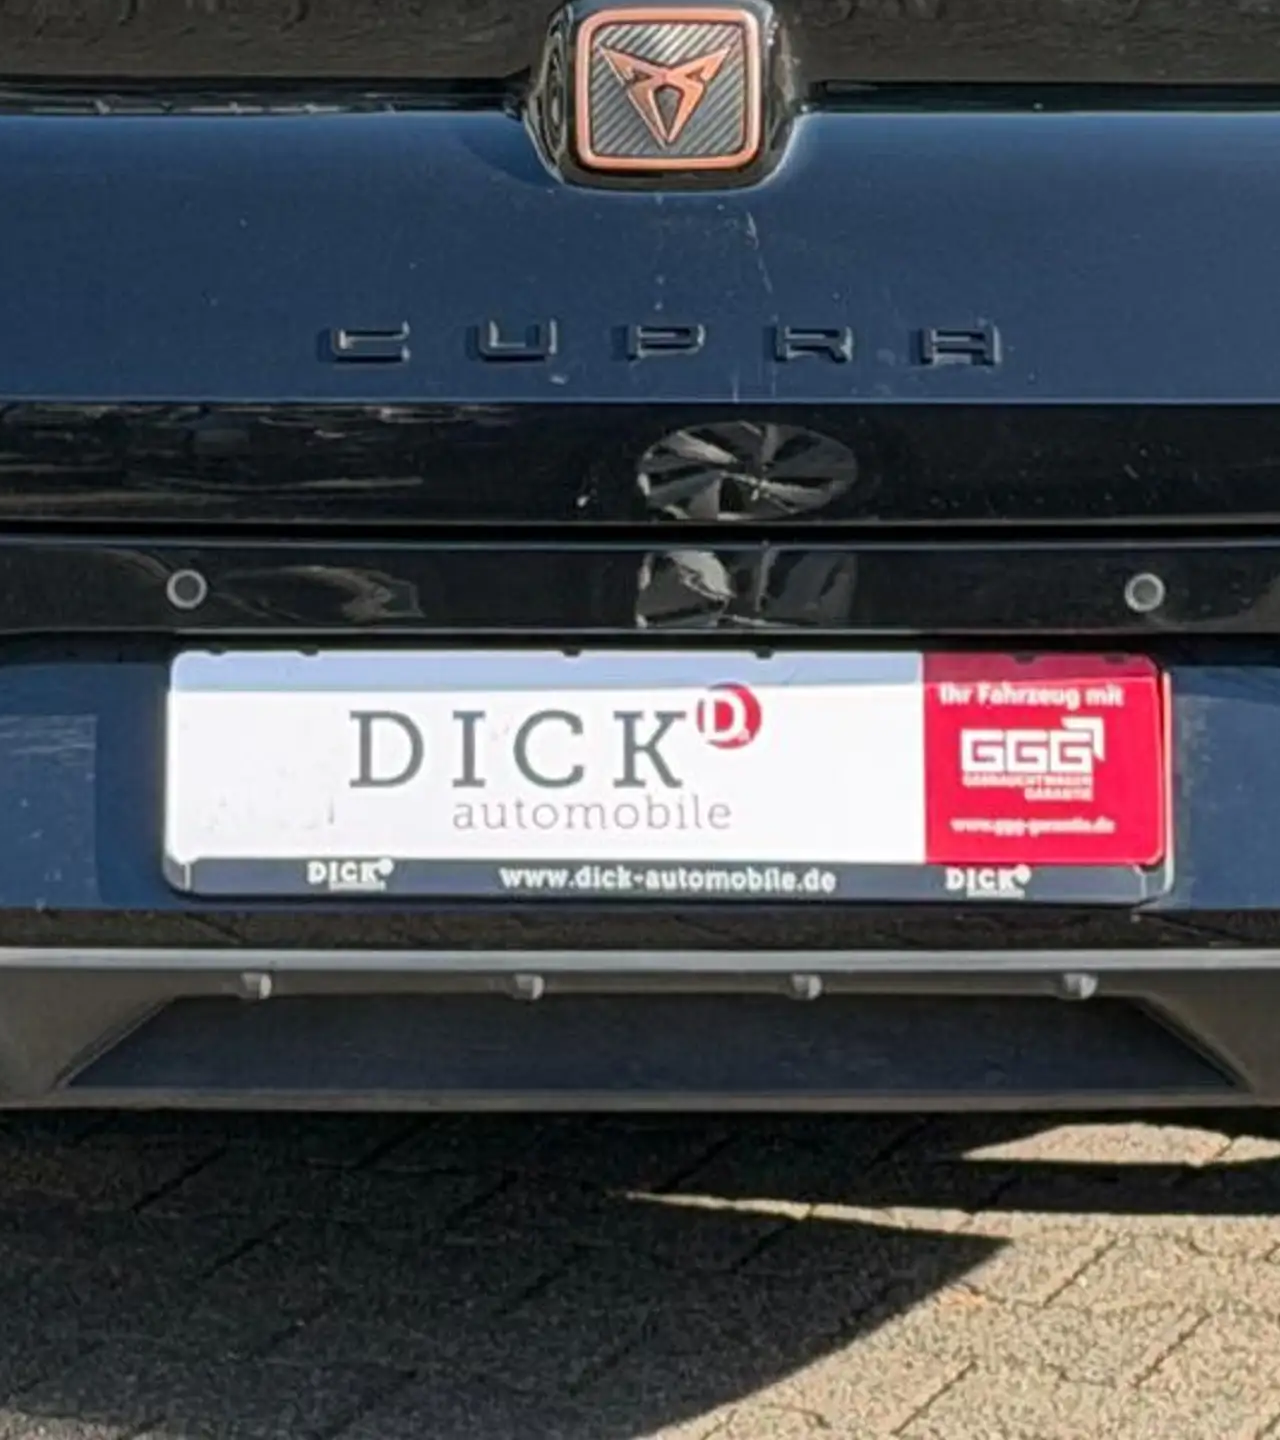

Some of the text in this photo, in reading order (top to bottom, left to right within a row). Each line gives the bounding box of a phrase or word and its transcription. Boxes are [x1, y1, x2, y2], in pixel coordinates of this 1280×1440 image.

[328, 317, 1004, 364] CUPRA
[940, 681, 1124, 711] Ihr Fahrzeug mit
[348, 709, 687, 789] DICK
[961, 728, 1094, 774] GGG
[452, 795, 733, 831] automobile
[306, 860, 380, 885] DICK
[500, 865, 838, 894] www.dick-automobile.de
[945, 866, 1016, 891] DICK
